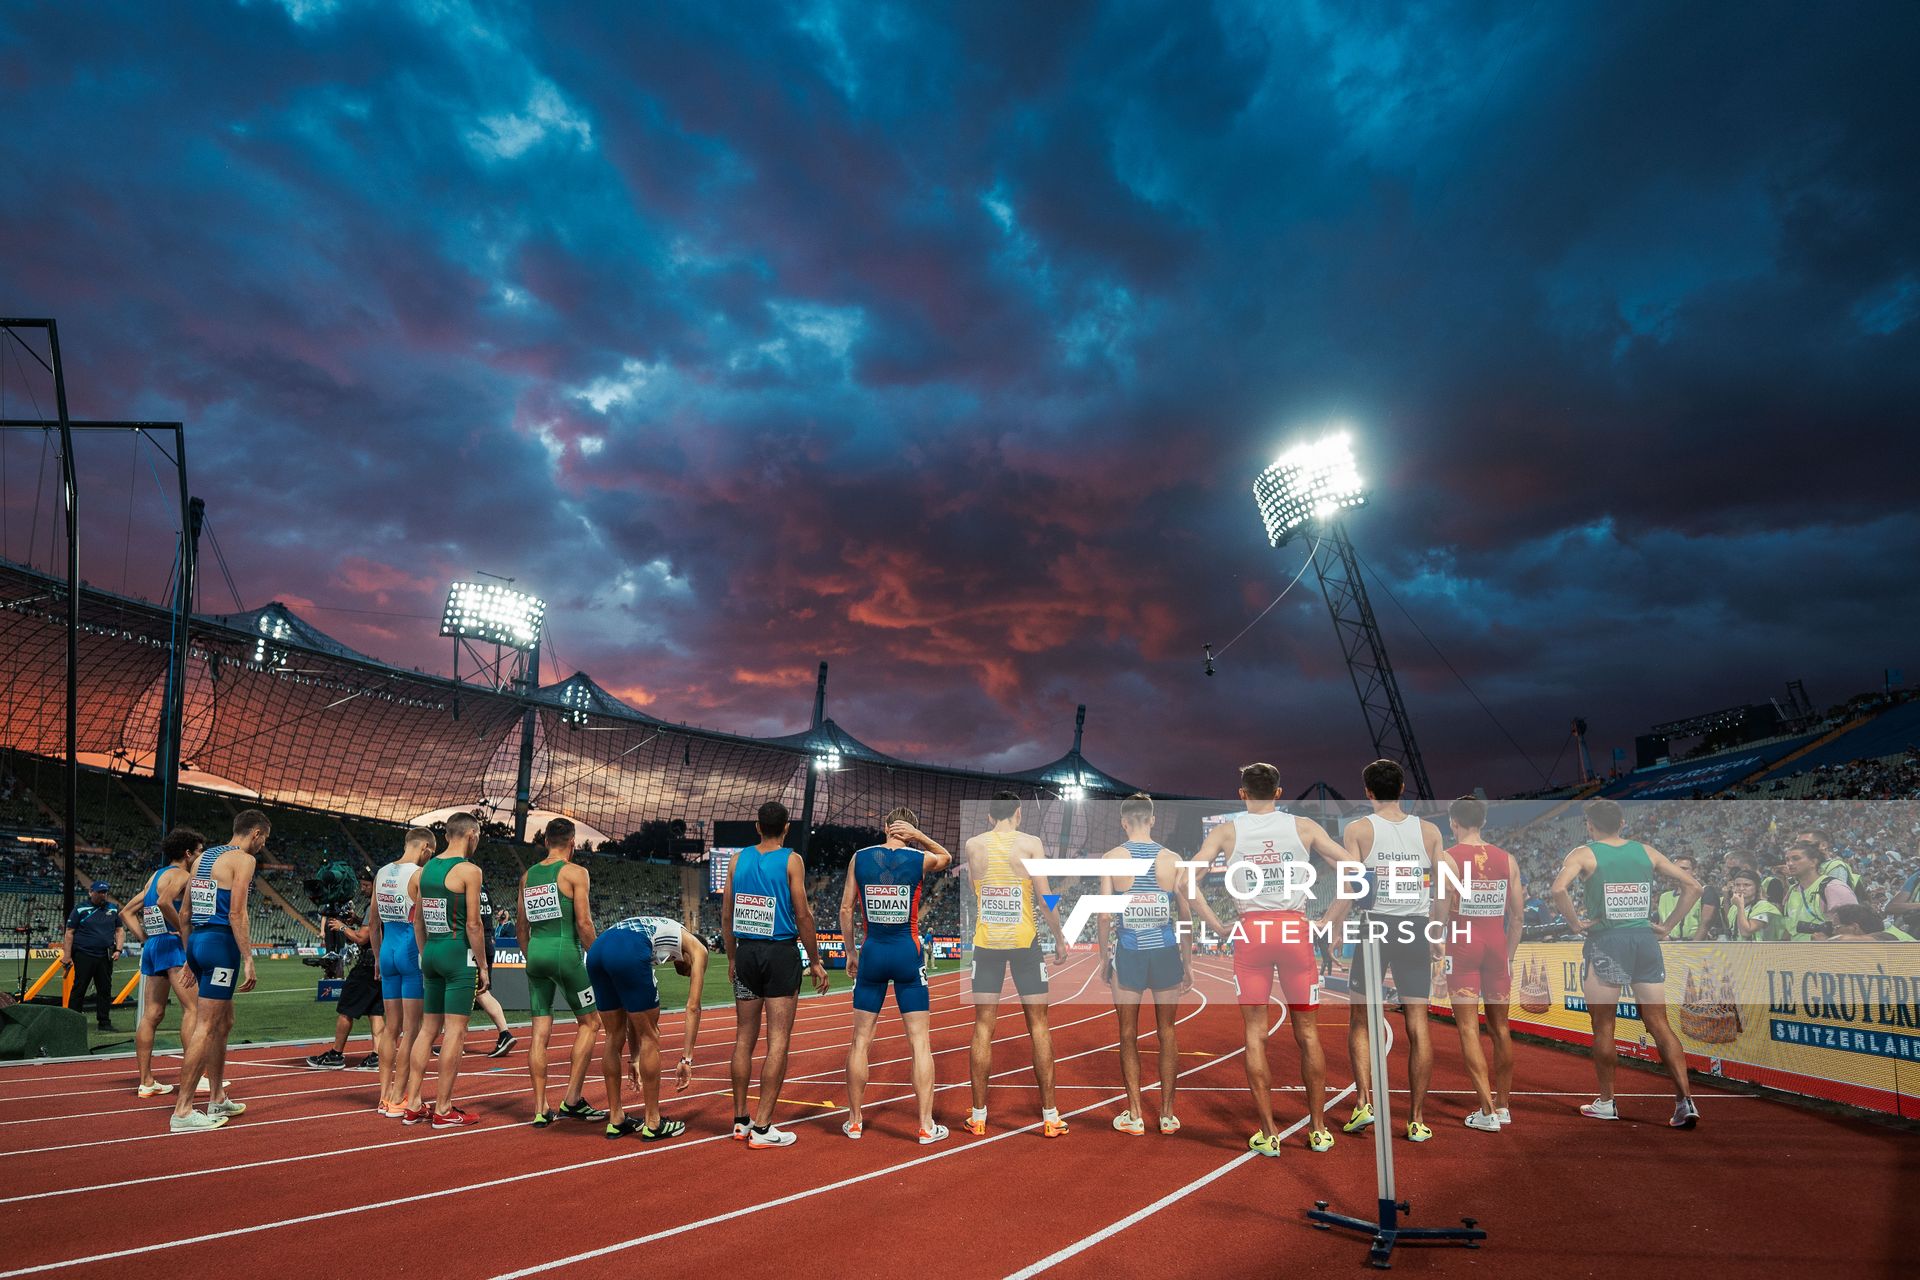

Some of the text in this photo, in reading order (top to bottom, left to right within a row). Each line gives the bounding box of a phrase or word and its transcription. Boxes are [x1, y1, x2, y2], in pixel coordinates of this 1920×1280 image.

[1377, 852, 1420, 862] Belgium
[866, 886, 897, 895] SPAR
[1377, 880, 1422, 891] VEREYDEN
[1606, 885, 1638, 893] SPAR
[525, 887, 548, 897] SPAR
[982, 887, 1010, 896] SPAR
[527, 897, 557, 909] SZÖGI
[737, 896, 766, 905] SPAR
[867, 899, 908, 910] EDMAN
[1131, 895, 1156, 903] PAR
[1606, 896, 1648, 907] COSCORAN
[981, 899, 1021, 911] KESSLER
[735, 908, 773, 921] MKRTCHYAN
[1124, 906, 1168, 917] STONIER
[735, 924, 759, 933] MUNICH
[35, 950, 60, 959] ADAC
[218, 972, 228, 983] 2
[1563, 961, 1578, 993] LE
[584, 991, 593, 1004] 5
[1766, 970, 1797, 1015] LE
[1775, 1022, 1920, 1059] SWITZERLAND
